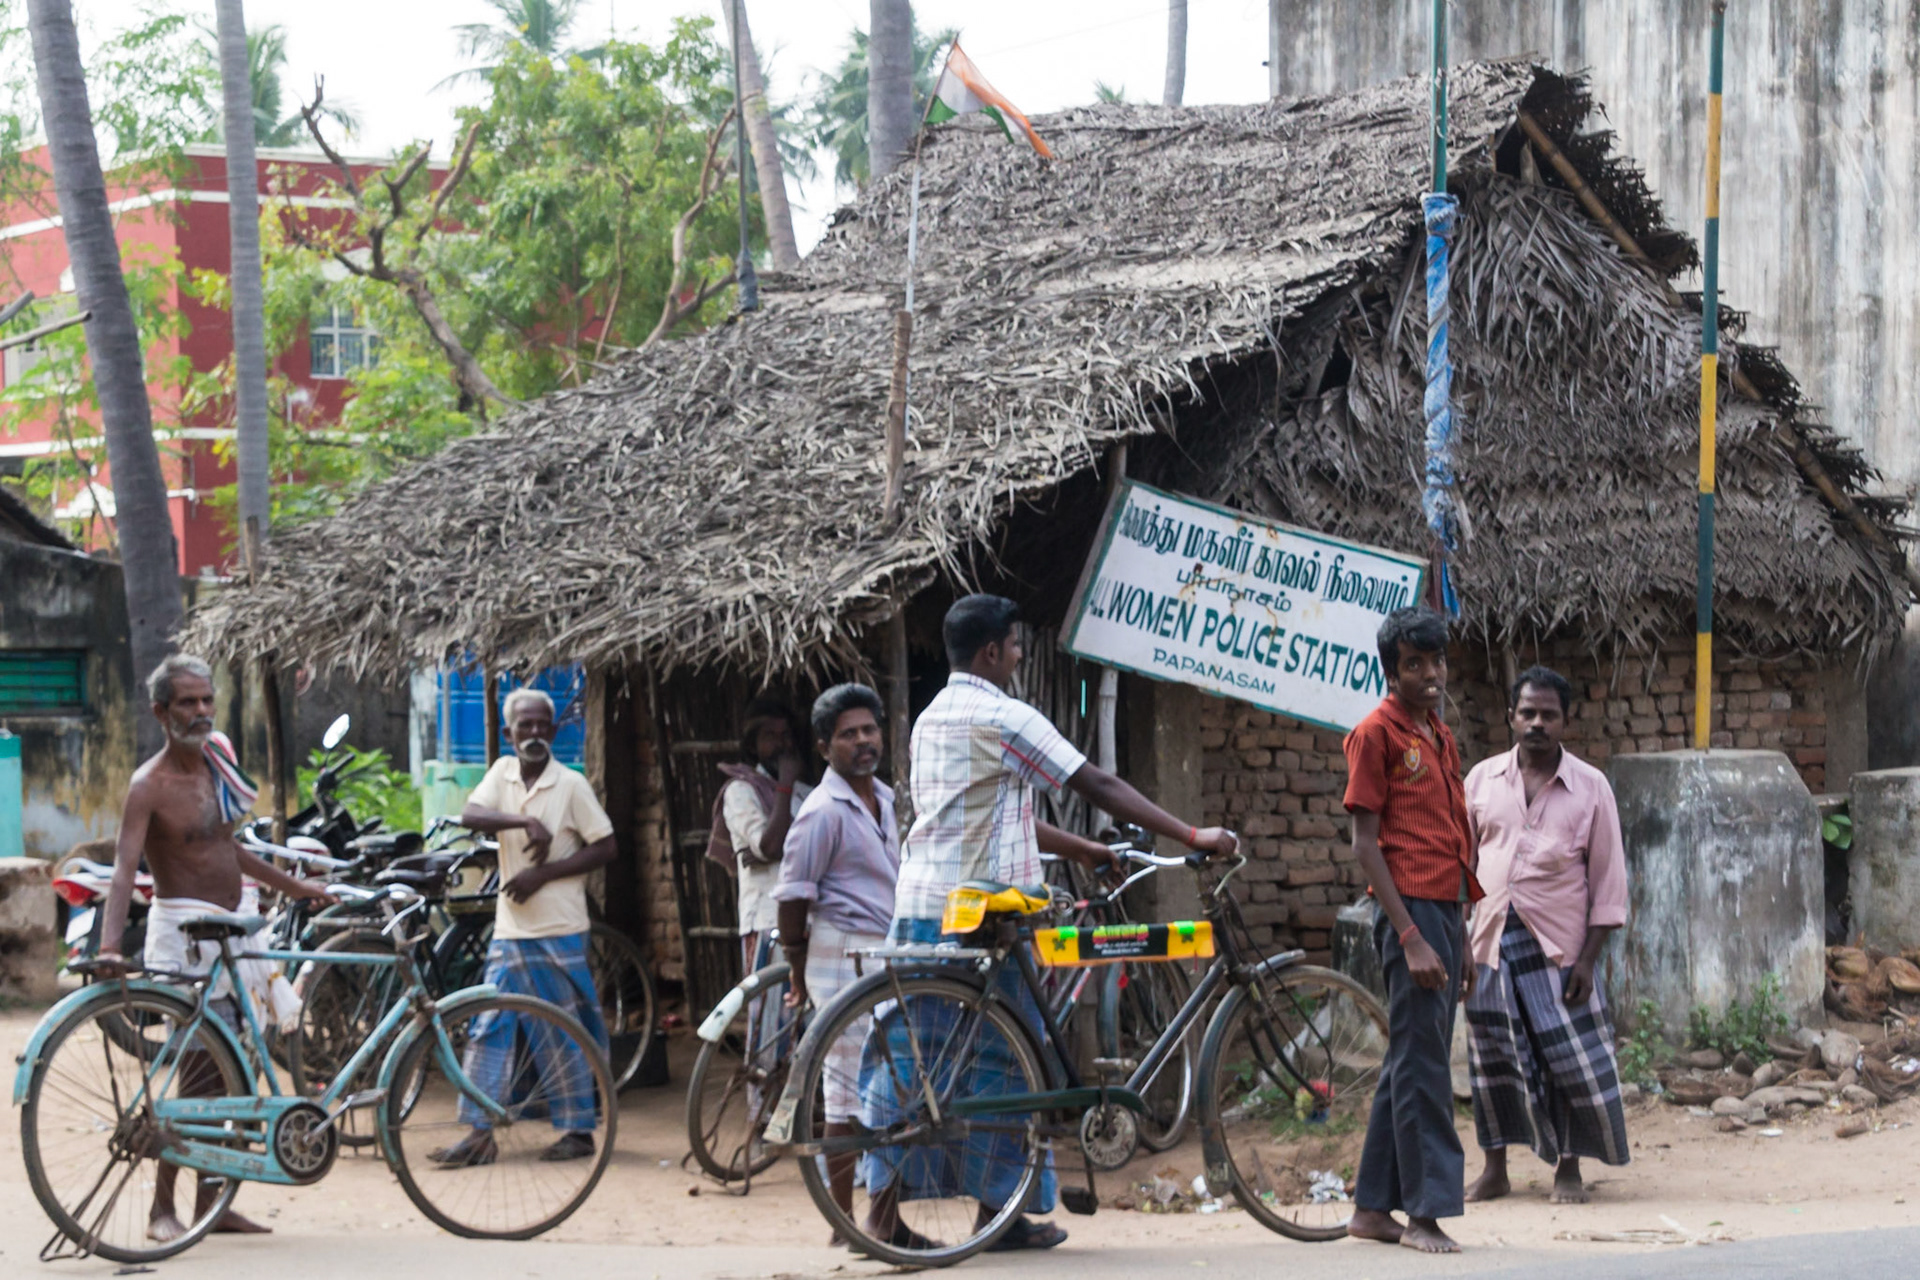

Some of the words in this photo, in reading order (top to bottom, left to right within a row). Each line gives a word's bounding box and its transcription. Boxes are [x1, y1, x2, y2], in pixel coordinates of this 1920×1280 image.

[1253, 549, 1322, 593] காவல்
[1322, 553, 1409, 616] நிலையம்
[1107, 580, 1197, 644] WOMEN
[1199, 607, 1286, 669] POLICE
[1283, 632, 1387, 698] STATION
[1153, 647, 1276, 695] PAPANASAM
